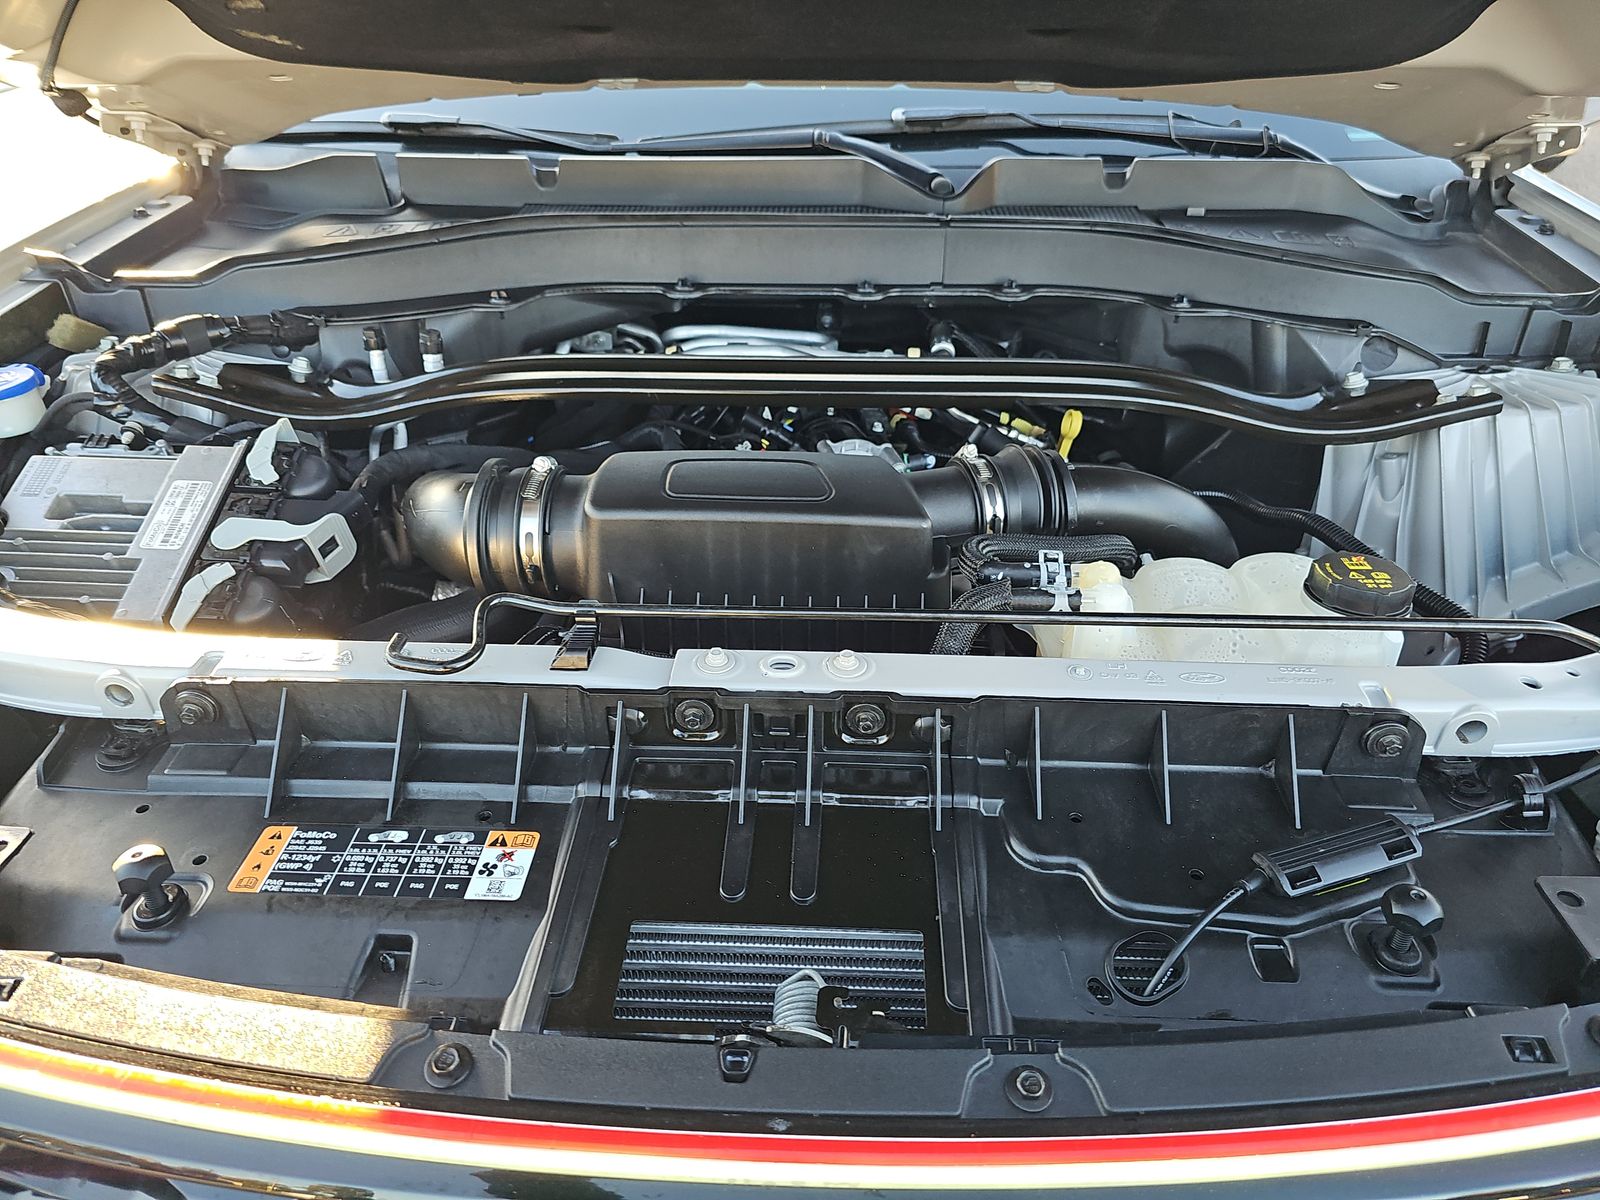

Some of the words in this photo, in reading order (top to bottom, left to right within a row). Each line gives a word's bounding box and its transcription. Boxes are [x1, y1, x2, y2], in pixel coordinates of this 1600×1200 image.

[293, 831, 338, 839] FoMoCo
[280, 854, 322, 862] R-1234yf
[365, 855, 374, 863] kg
[275, 862, 303, 870] (GWP
[303, 863, 313, 871] 4)
